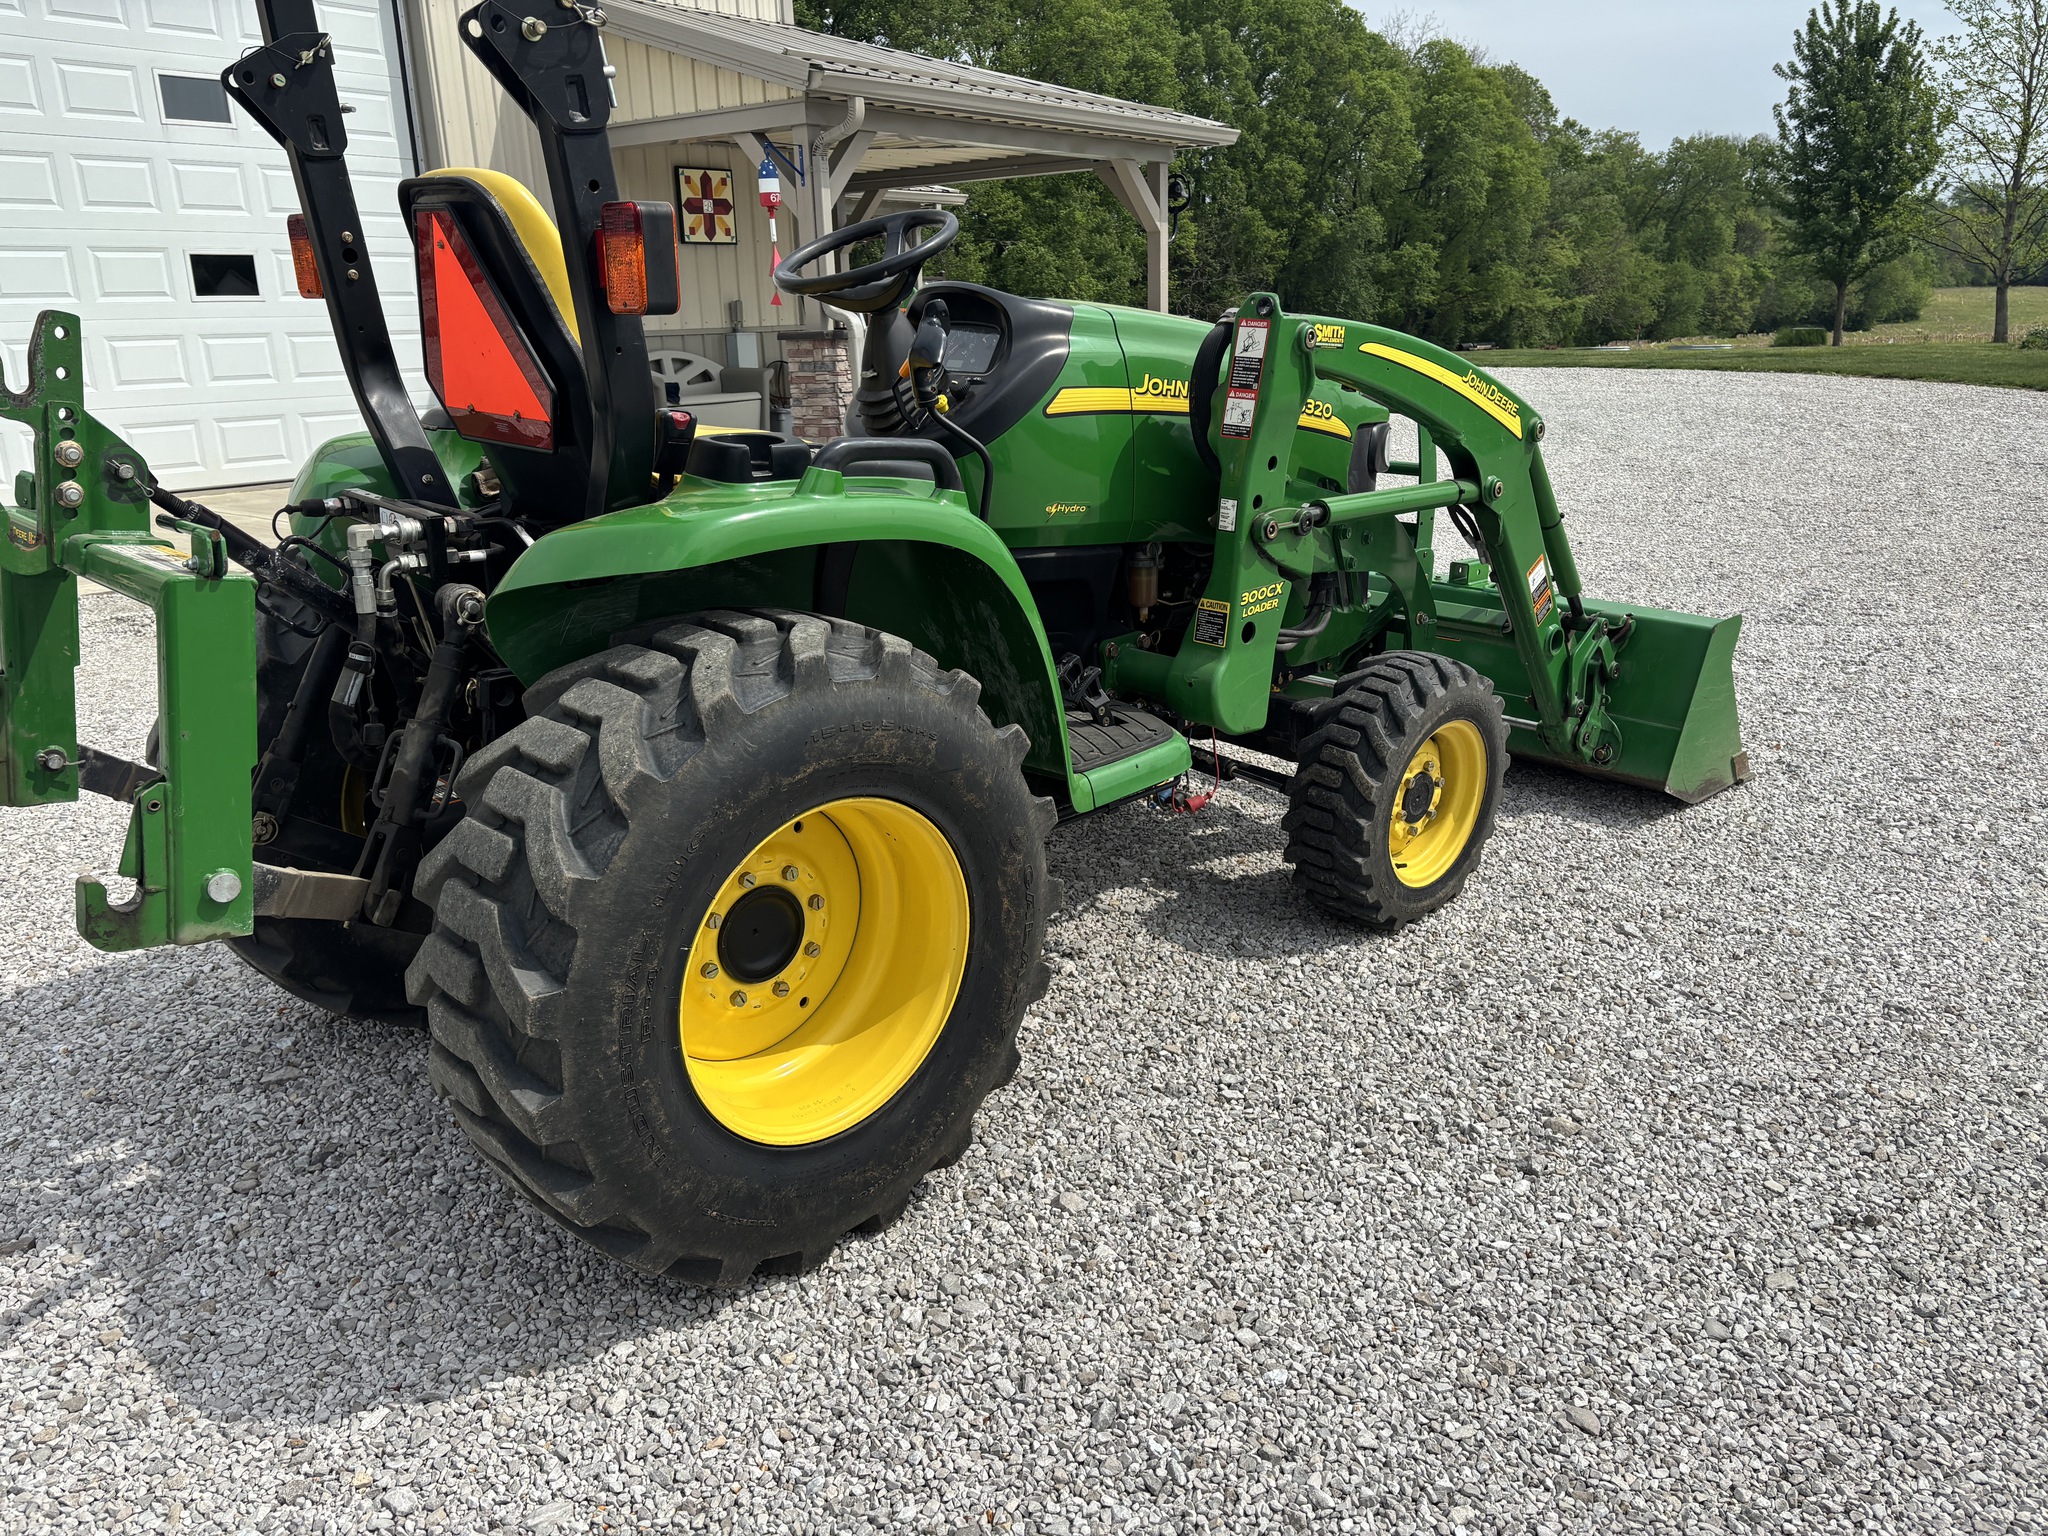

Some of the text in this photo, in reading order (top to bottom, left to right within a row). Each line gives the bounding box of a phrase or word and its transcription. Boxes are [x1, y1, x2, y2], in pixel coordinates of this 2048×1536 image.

[1314, 323, 1345, 342] SMITH
[1135, 373, 1189, 397] JOHN
[1462, 369, 1519, 416] JOHN DEERE
[1301, 398, 1333, 418] 320
[1240, 581, 1284, 606] 300CX
[1205, 600, 1228, 611] CAUTION
[1242, 598, 1279, 617] LOADER
[619, 938, 668, 1168] INDUSTRIAL
